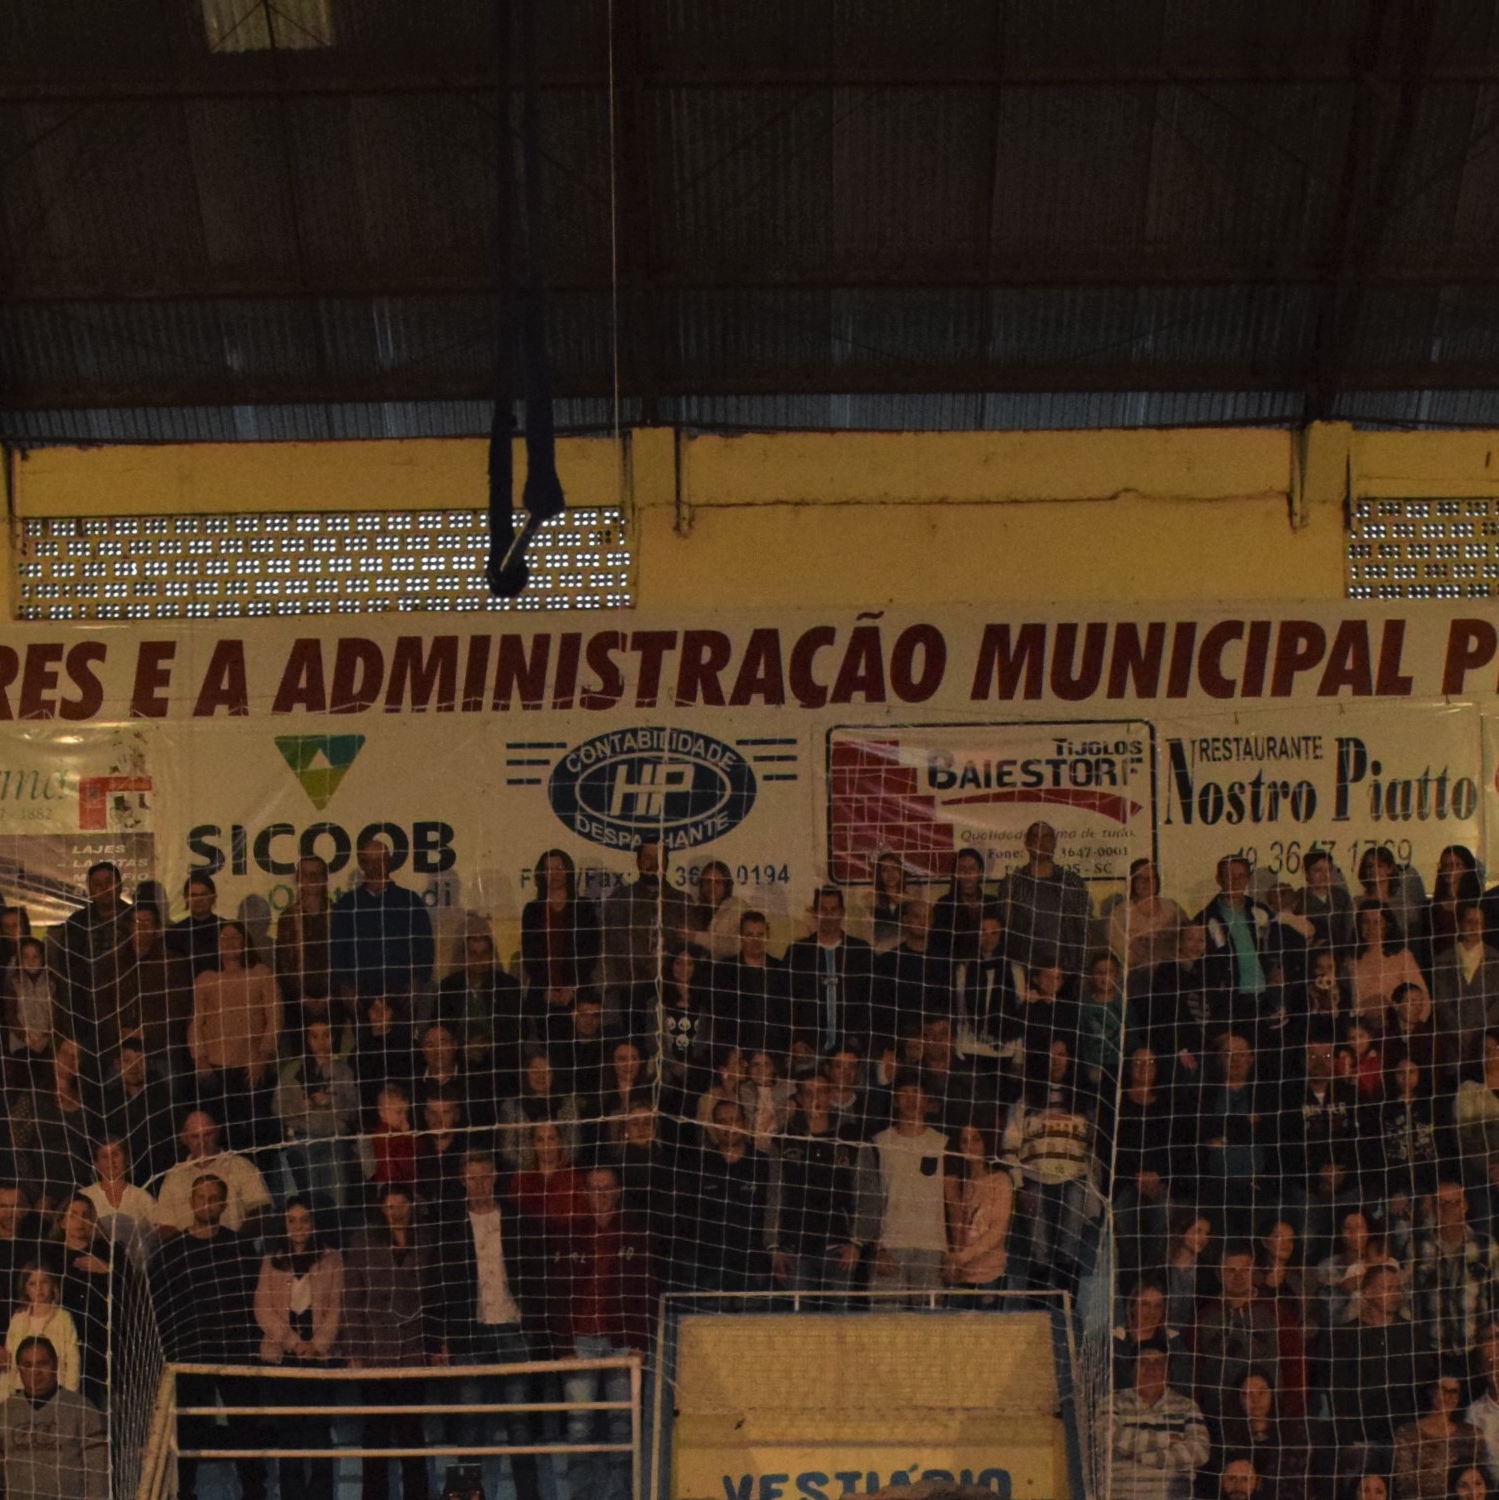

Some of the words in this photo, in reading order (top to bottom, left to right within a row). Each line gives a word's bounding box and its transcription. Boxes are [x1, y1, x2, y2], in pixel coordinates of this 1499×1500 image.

[131, 640, 177, 718] E
[192, 639, 248, 717] A
[271, 612, 947, 715] ADMINISTRAÇÃO
[970, 618, 1414, 701] MUNICIPAL
[565, 727, 738, 775] CONTABILIDADE
[1199, 736, 1324, 762] RESTAURANTE
[609, 763, 696, 817] HP
[1164, 738, 1318, 825] Nostro
[1331, 736, 1478, 822] Piatto
[72, 844, 126, 855] LAJES
[188, 821, 457, 876] SICOOB
[574, 810, 731, 850] DESPAHANTE
[988, 848, 1024, 860] Fone:
